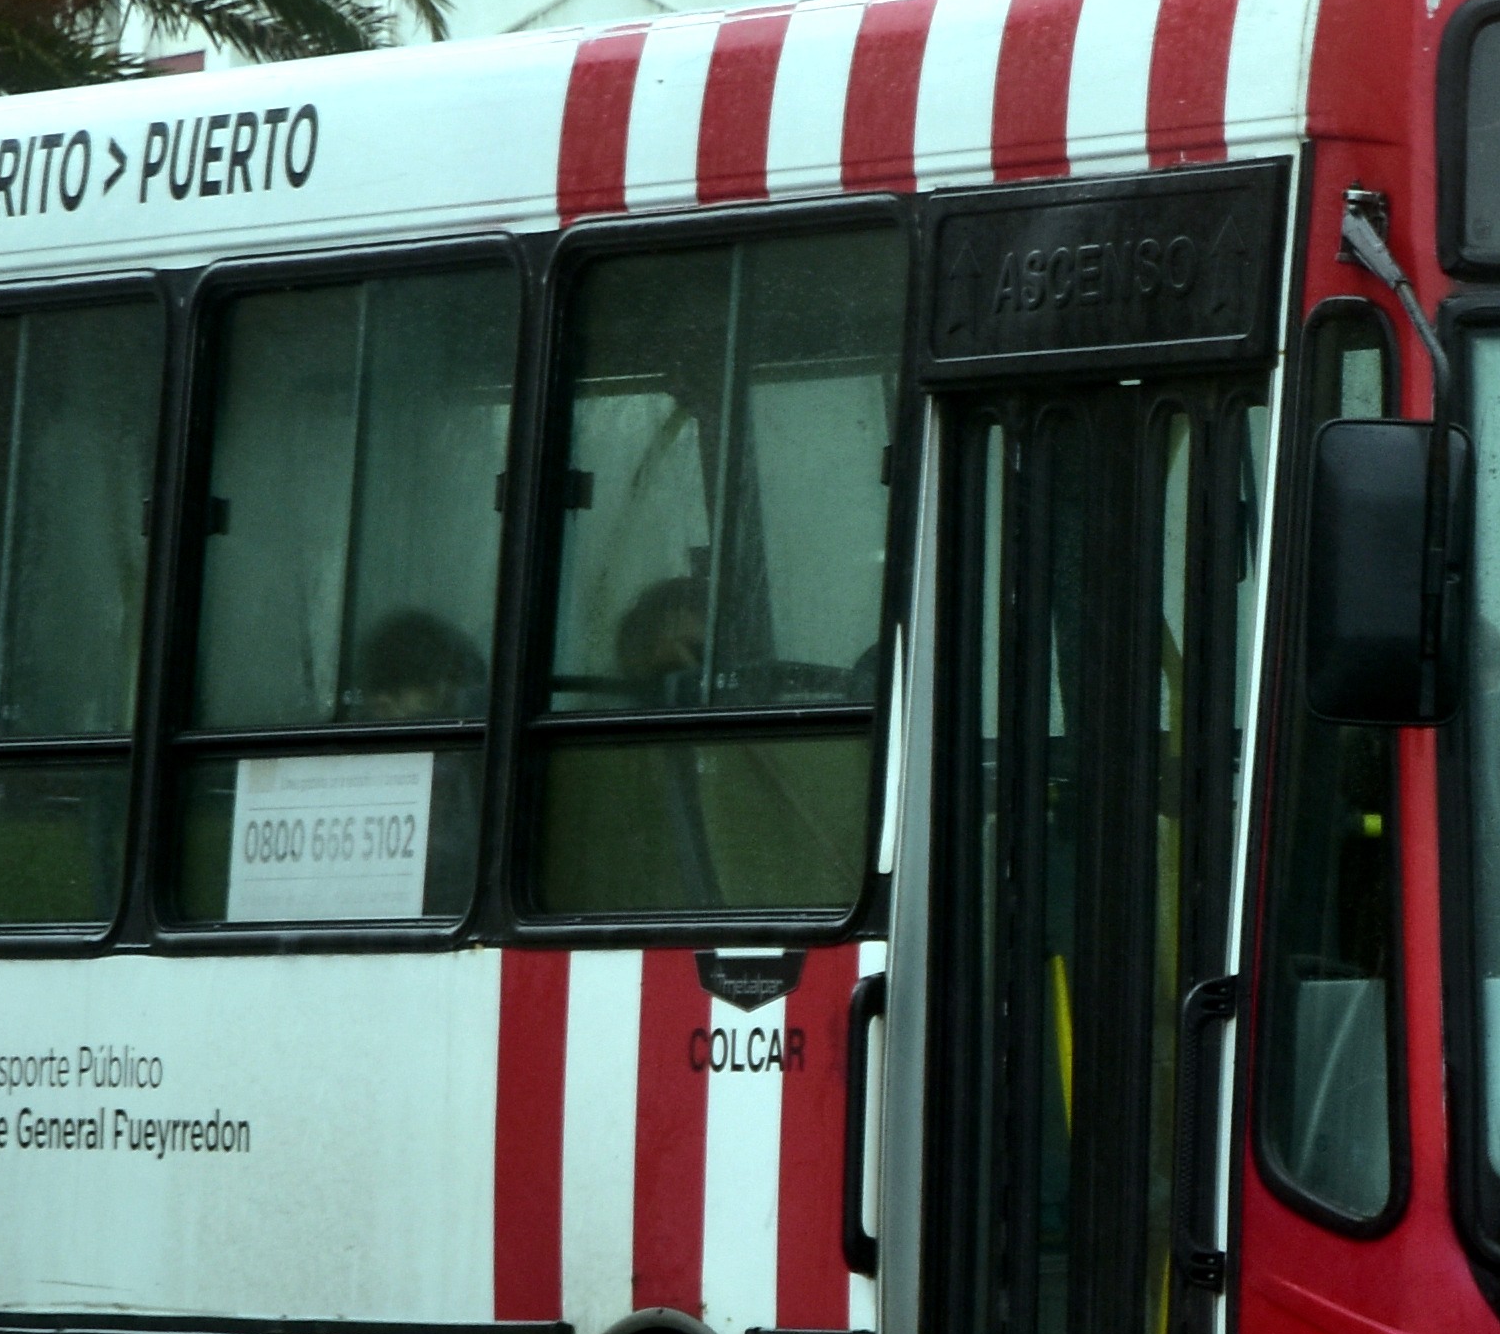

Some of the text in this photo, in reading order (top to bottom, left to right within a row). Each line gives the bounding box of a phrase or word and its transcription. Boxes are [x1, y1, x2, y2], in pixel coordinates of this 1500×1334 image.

[140, 102, 320, 205] PUERTO
[991, 234, 1198, 315] ASCENSO
[244, 813, 417, 864] 0800 666 5102
[78, 1044, 164, 1089] Público
[689, 1026, 806, 1074] COLCAR
[16, 1106, 106, 1150] General
